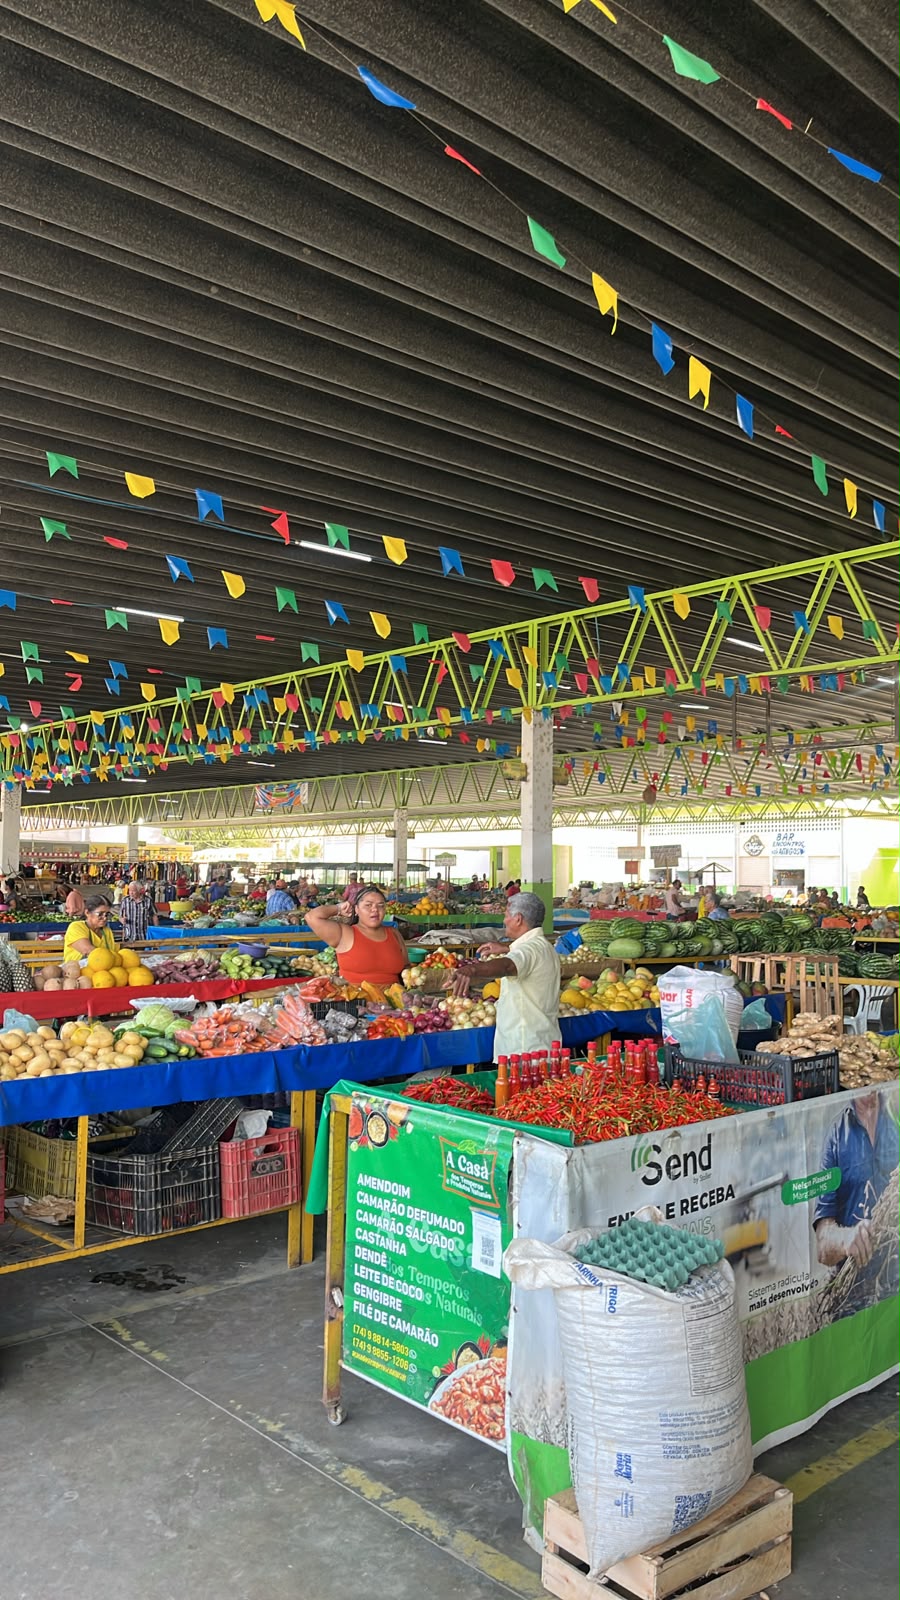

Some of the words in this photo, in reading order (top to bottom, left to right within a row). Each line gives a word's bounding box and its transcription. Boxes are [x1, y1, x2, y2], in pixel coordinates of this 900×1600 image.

[776, 833, 795, 841] BAR
[446, 1150, 455, 1168] A
[457, 1154, 489, 1180] Casa
[641, 1132, 712, 1186] Send
[357, 1173, 411, 1199] AMENDOIM
[356, 1191, 405, 1217] CAMARÃO
[406, 1206, 465, 1235] DEFUMADO
[665, 1202, 675, 1220] E
[680, 1184, 736, 1216] RECEBA
[355, 1227, 407, 1257] CASTANHA
[356, 1209, 404, 1236] CAMARÃO
[405, 1225, 455, 1252] SALGADO
[354, 1245, 388, 1268] DENDÊ
[354, 1263, 381, 1285] LEITE
[381, 1273, 395, 1290] DE
[408, 1265, 470, 1302] Temperos
[748, 1282, 776, 1300] Sistema
[353, 1281, 403, 1313] GENGIBRE
[435, 1293, 483, 1327] Naturais
[749, 1297, 767, 1313] mais
[352, 1324, 367, 1338] (74)
[367, 1330, 372, 1340] 9
[353, 1300, 373, 1320] FILÉ
[373, 1308, 388, 1326] DE
[388, 1315, 439, 1347] CAMARÃO
[352, 1337, 366, 1351] (74)
[366, 1343, 372, 1353] 9
[614, 1452, 624, 1479] Dona
